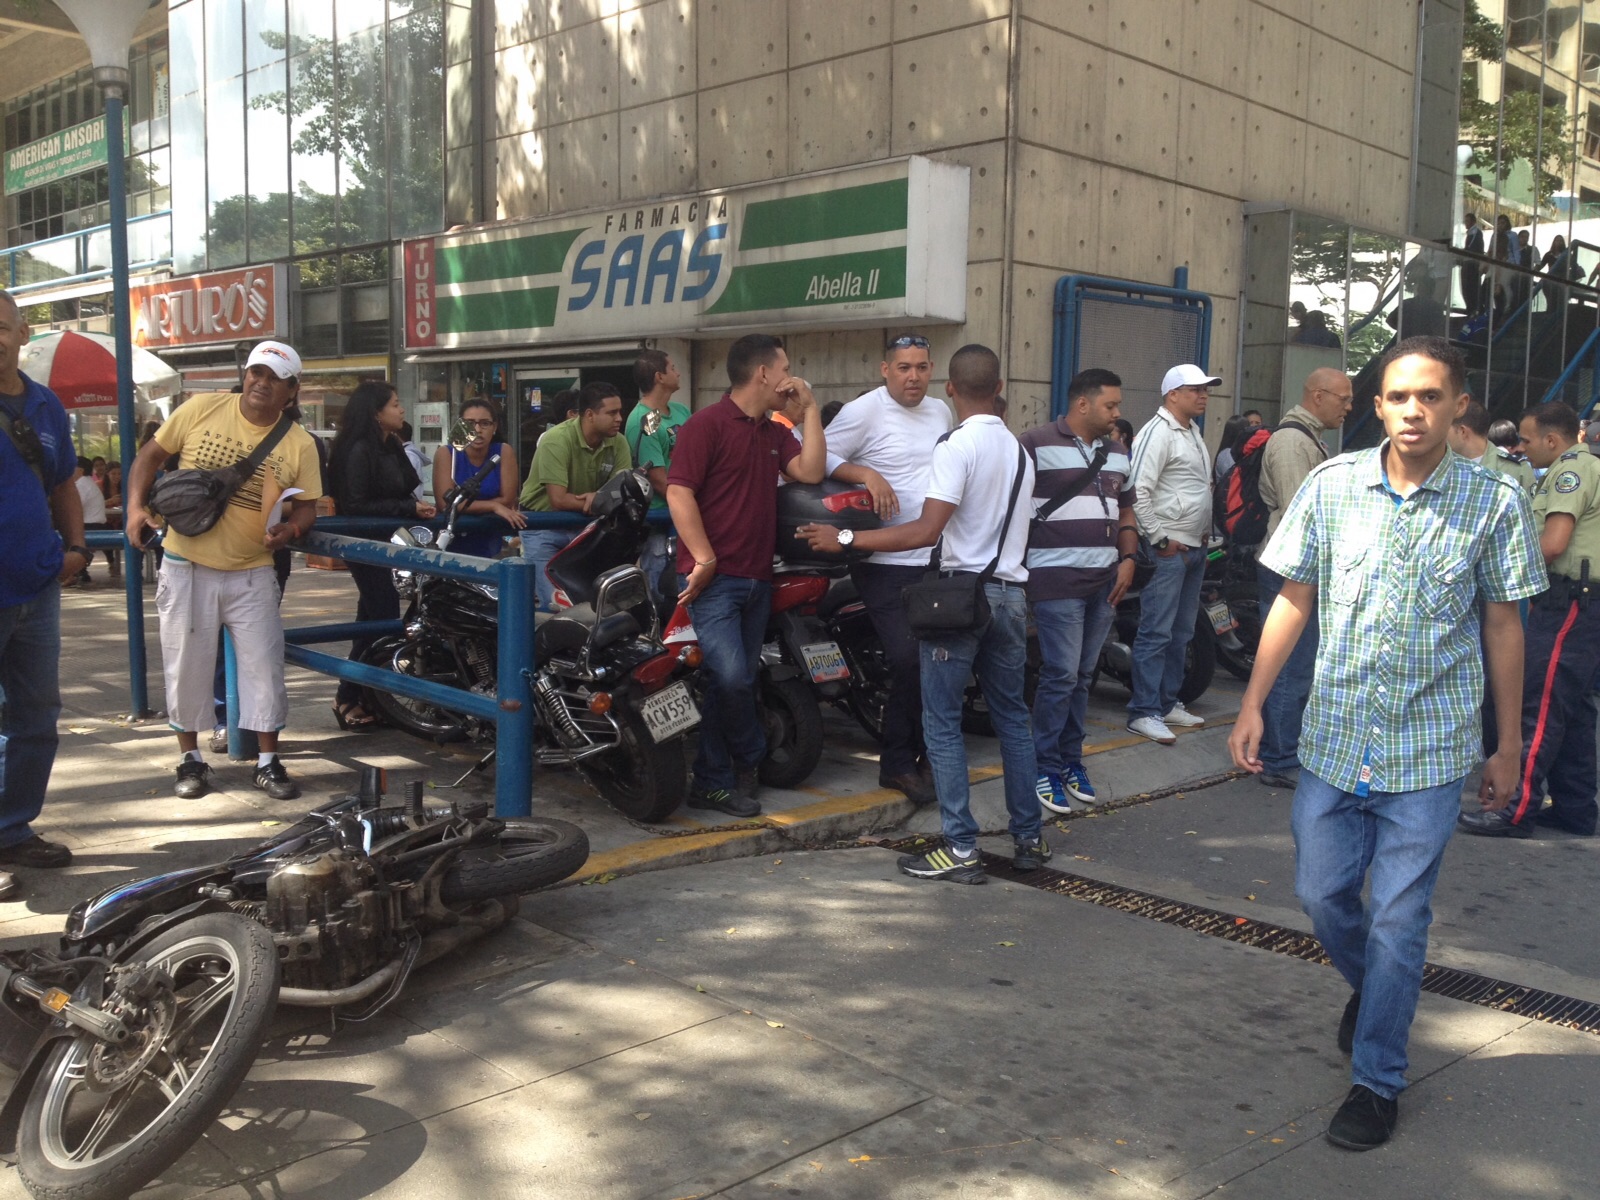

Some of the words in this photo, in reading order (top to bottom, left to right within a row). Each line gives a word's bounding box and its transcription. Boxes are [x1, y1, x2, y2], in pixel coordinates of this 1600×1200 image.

[10, 136, 61, 172] AMERICAN
[64, 119, 105, 152] ANSORI
[605, 198, 727, 234] FARMACIA
[567, 223, 728, 311] SAAS
[805, 271, 862, 301] Abella
[134, 271, 268, 341] ARTURO'S
[415, 242, 431, 338] TURNO
[203, 430, 285, 463] APPROED
[646, 689, 679, 709] VENEZUELA
